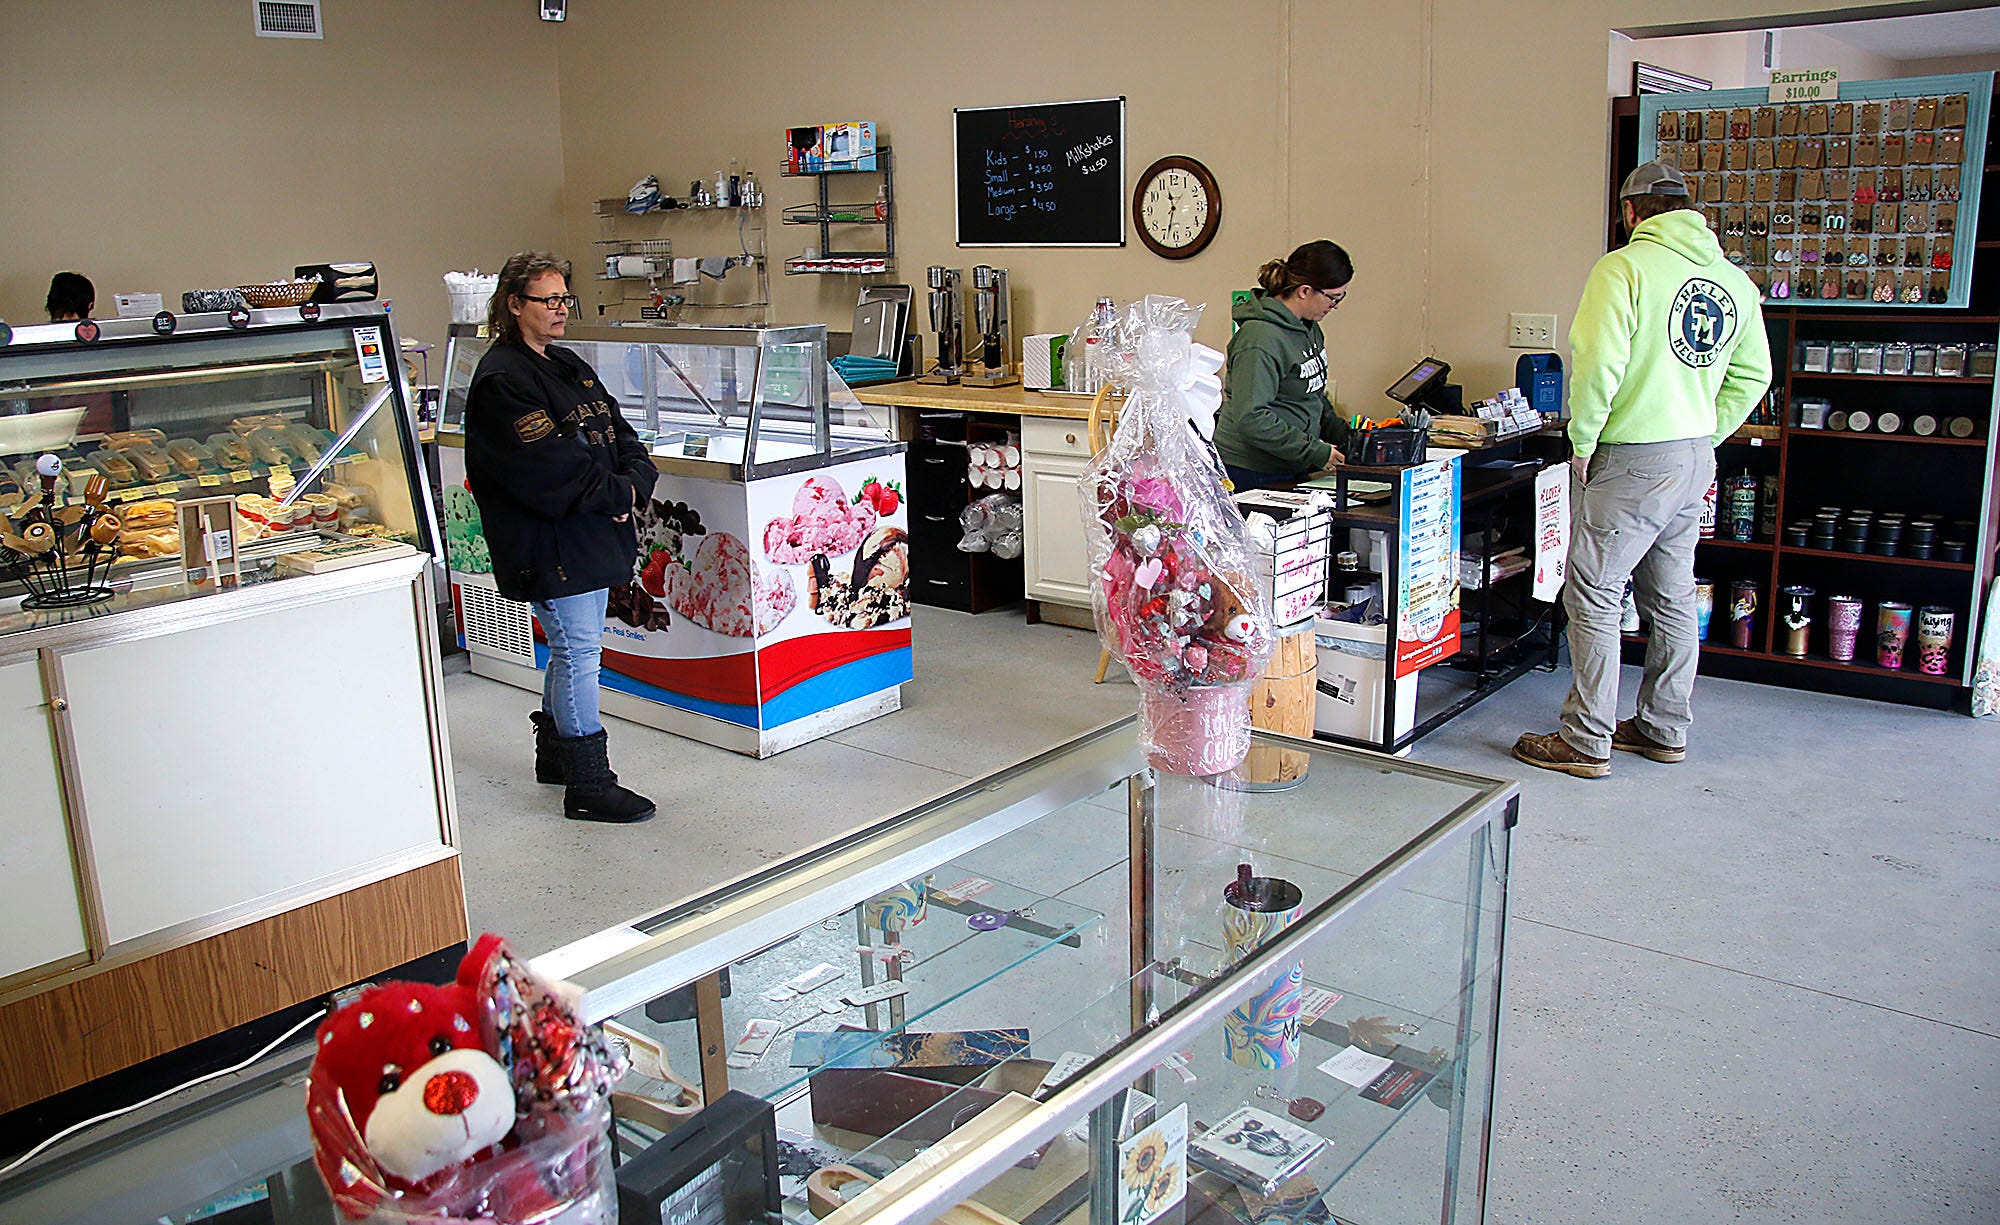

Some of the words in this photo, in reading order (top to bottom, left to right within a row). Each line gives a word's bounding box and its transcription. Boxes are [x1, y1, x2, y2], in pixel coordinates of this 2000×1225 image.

[1771, 70, 1837, 84] Earrings
[1785, 86, 1820, 99] $10.00
[986, 149, 1008, 167] Kids
[984, 169, 1009, 185] Small
[1169, 174, 1179, 186] 12
[1159, 179, 1166, 190] 11
[987, 186, 1016, 198] Medium
[1150, 191, 1160, 202] 10
[1191, 185, 1198, 198] 2
[987, 201, 1017, 221] Large
[1146, 206, 1153, 216] 9
[1196, 201, 1204, 211] 3
[1152, 220, 1159, 231] 8
[1193, 216, 1199, 227] 4
[1161, 228, 1167, 240] 7
[1172, 231, 1180, 241] 6
[1184, 226, 1192, 238] 5
[1920, 611, 1952, 632] Raising
